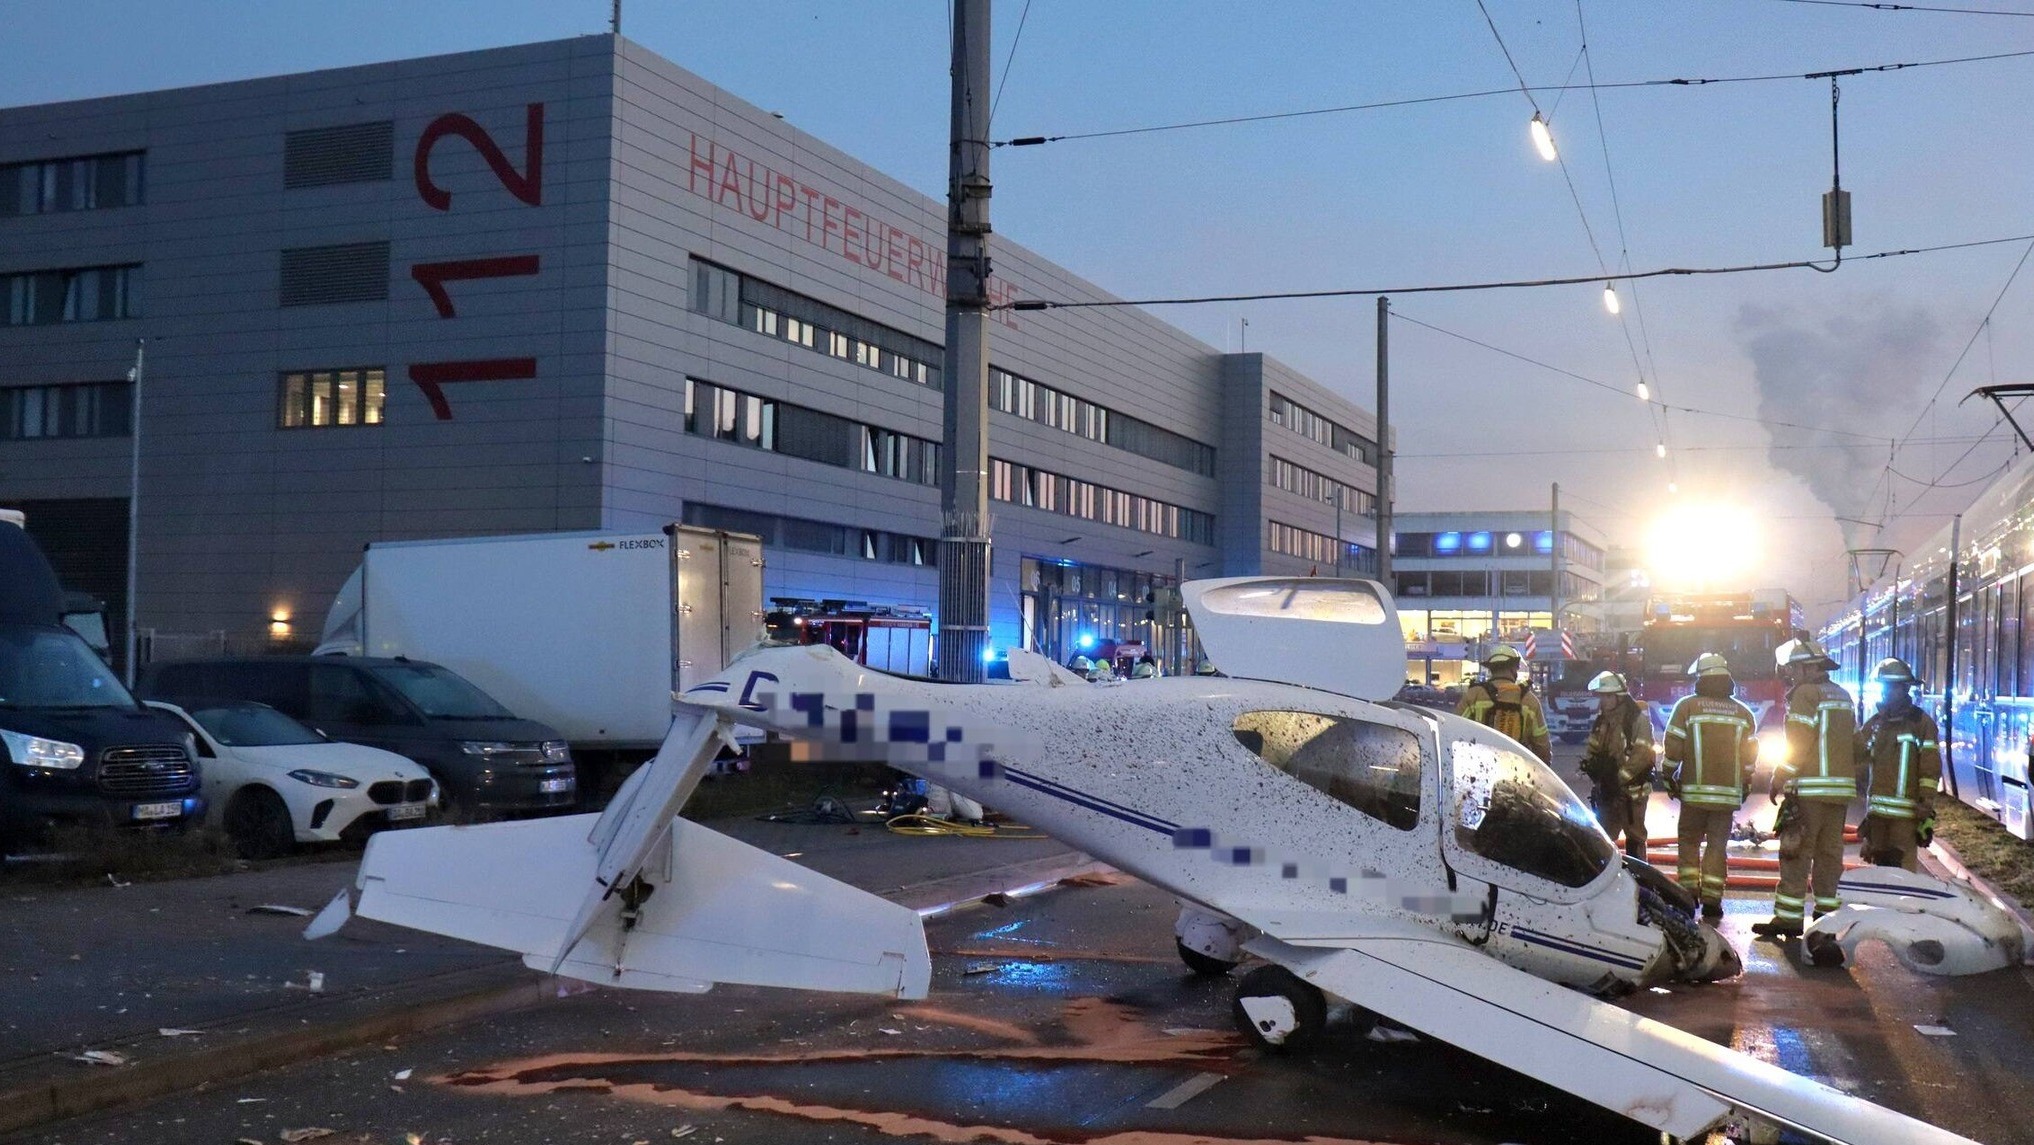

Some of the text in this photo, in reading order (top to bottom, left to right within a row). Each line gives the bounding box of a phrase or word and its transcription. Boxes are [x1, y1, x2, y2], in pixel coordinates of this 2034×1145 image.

[408, 102, 545, 421] 112
[689, 133, 1019, 331] HAUPTFEUERWHE
[619, 538, 665, 550] FLEXBOX
[1071, 575, 1081, 594] 05
